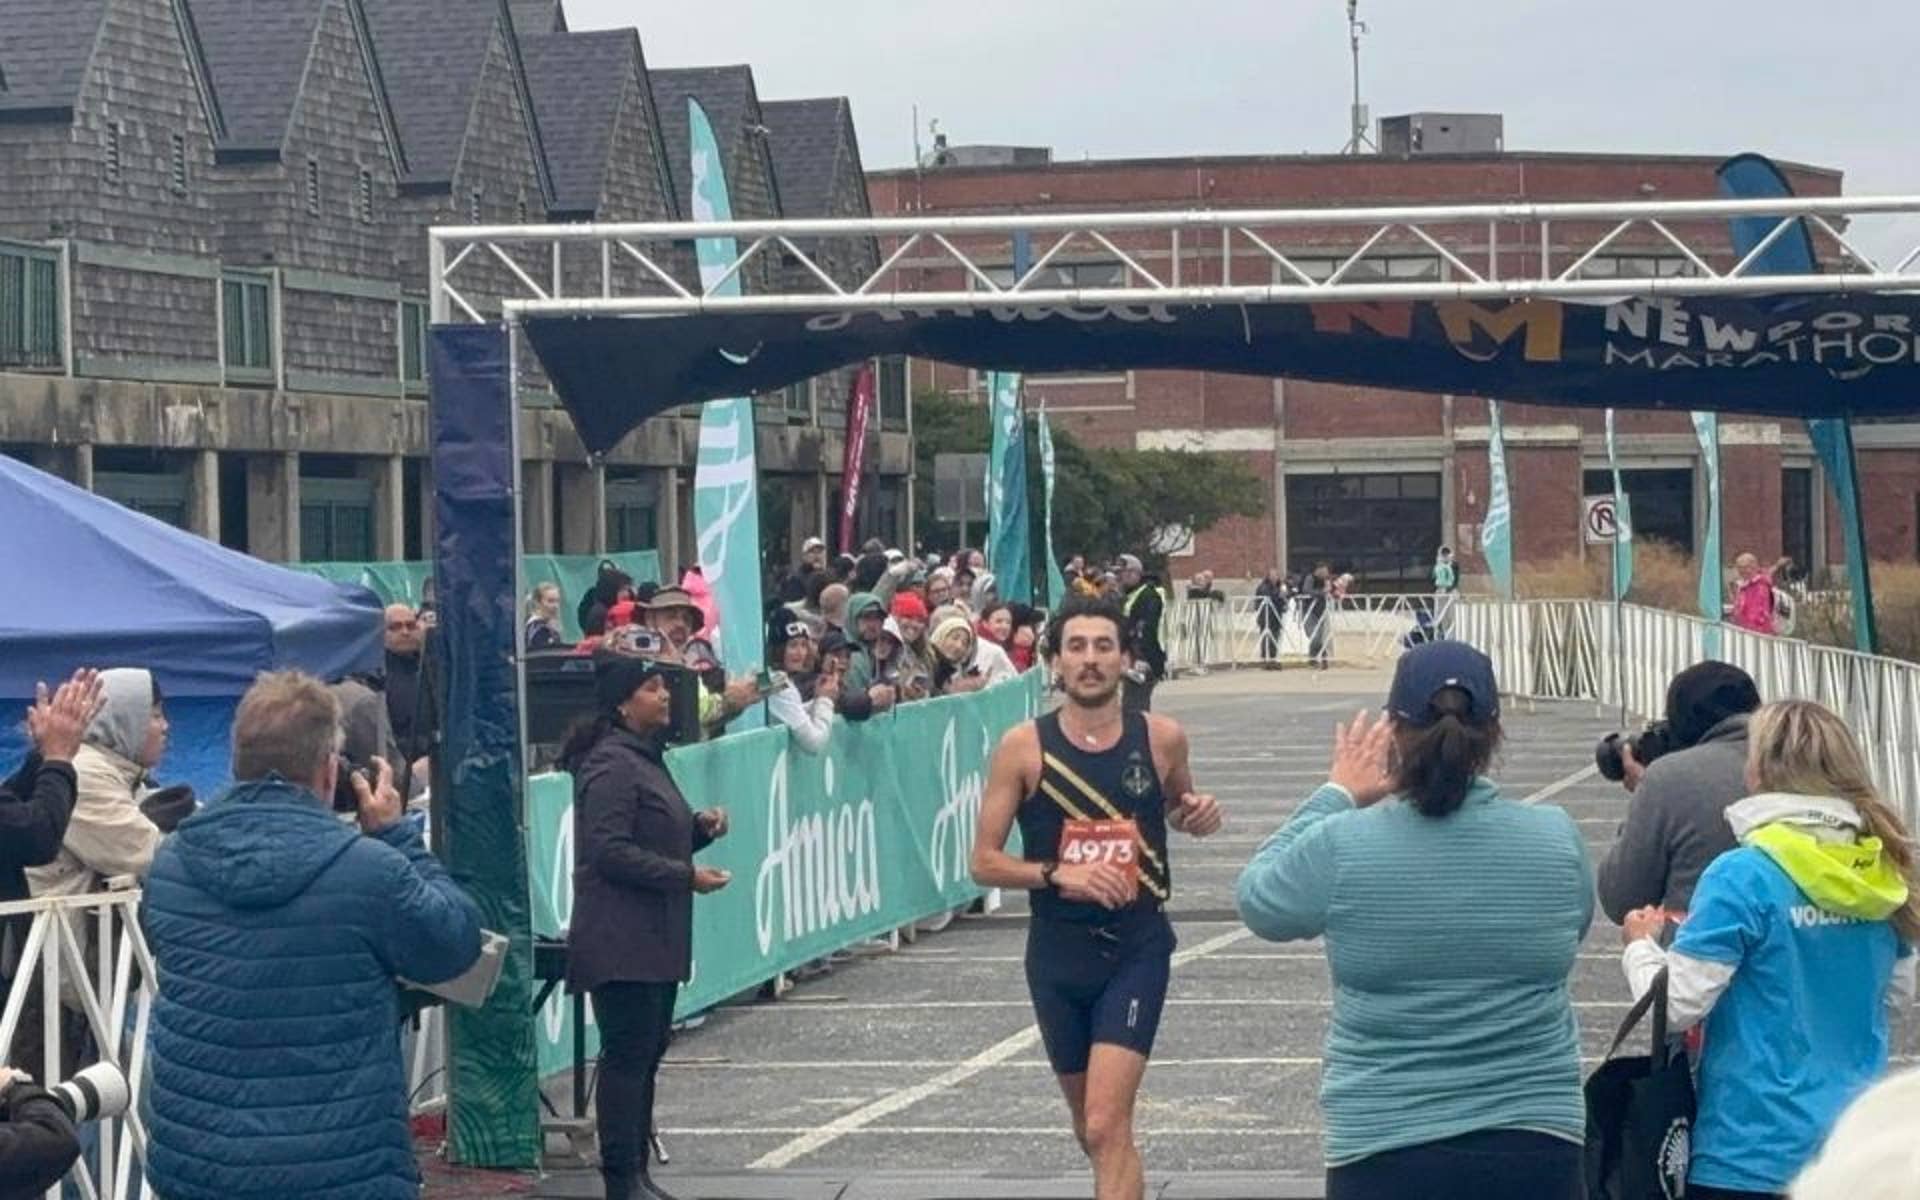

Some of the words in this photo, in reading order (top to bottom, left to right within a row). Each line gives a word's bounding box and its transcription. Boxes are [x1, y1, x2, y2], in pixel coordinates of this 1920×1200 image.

[1604, 297, 1913, 351] NEWPOR
[755, 749, 881, 957] Amica
[1063, 839, 1133, 864] 4973
